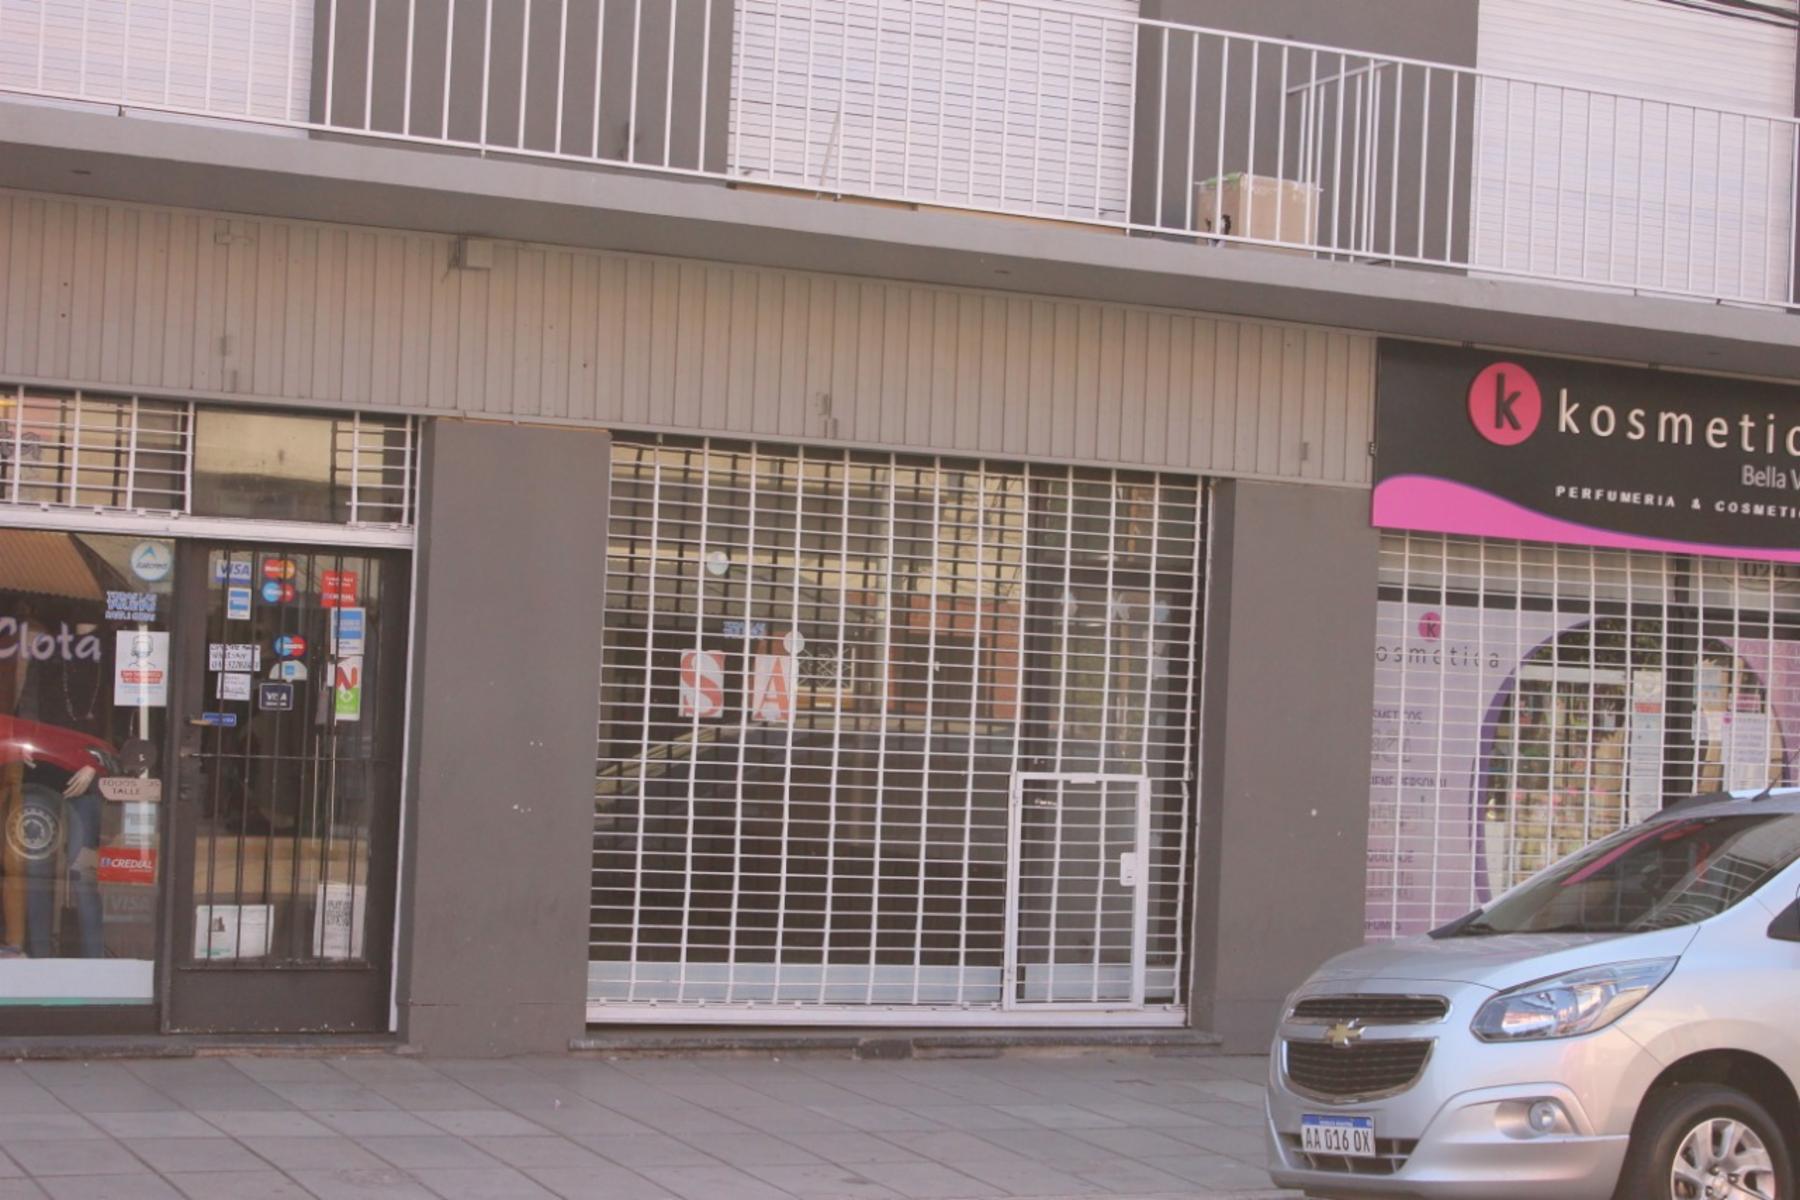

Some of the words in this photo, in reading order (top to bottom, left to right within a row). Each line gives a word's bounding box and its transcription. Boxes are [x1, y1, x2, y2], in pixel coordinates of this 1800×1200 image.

[1494, 373, 1522, 431] k
[1741, 464, 1786, 489] Bella
[1555, 485, 1675, 507] PERFUMERIA
[1714, 500, 1800, 518] COSMETI
[1305, 1127, 1322, 1150] AA
[1324, 1128, 1350, 1151] 016
